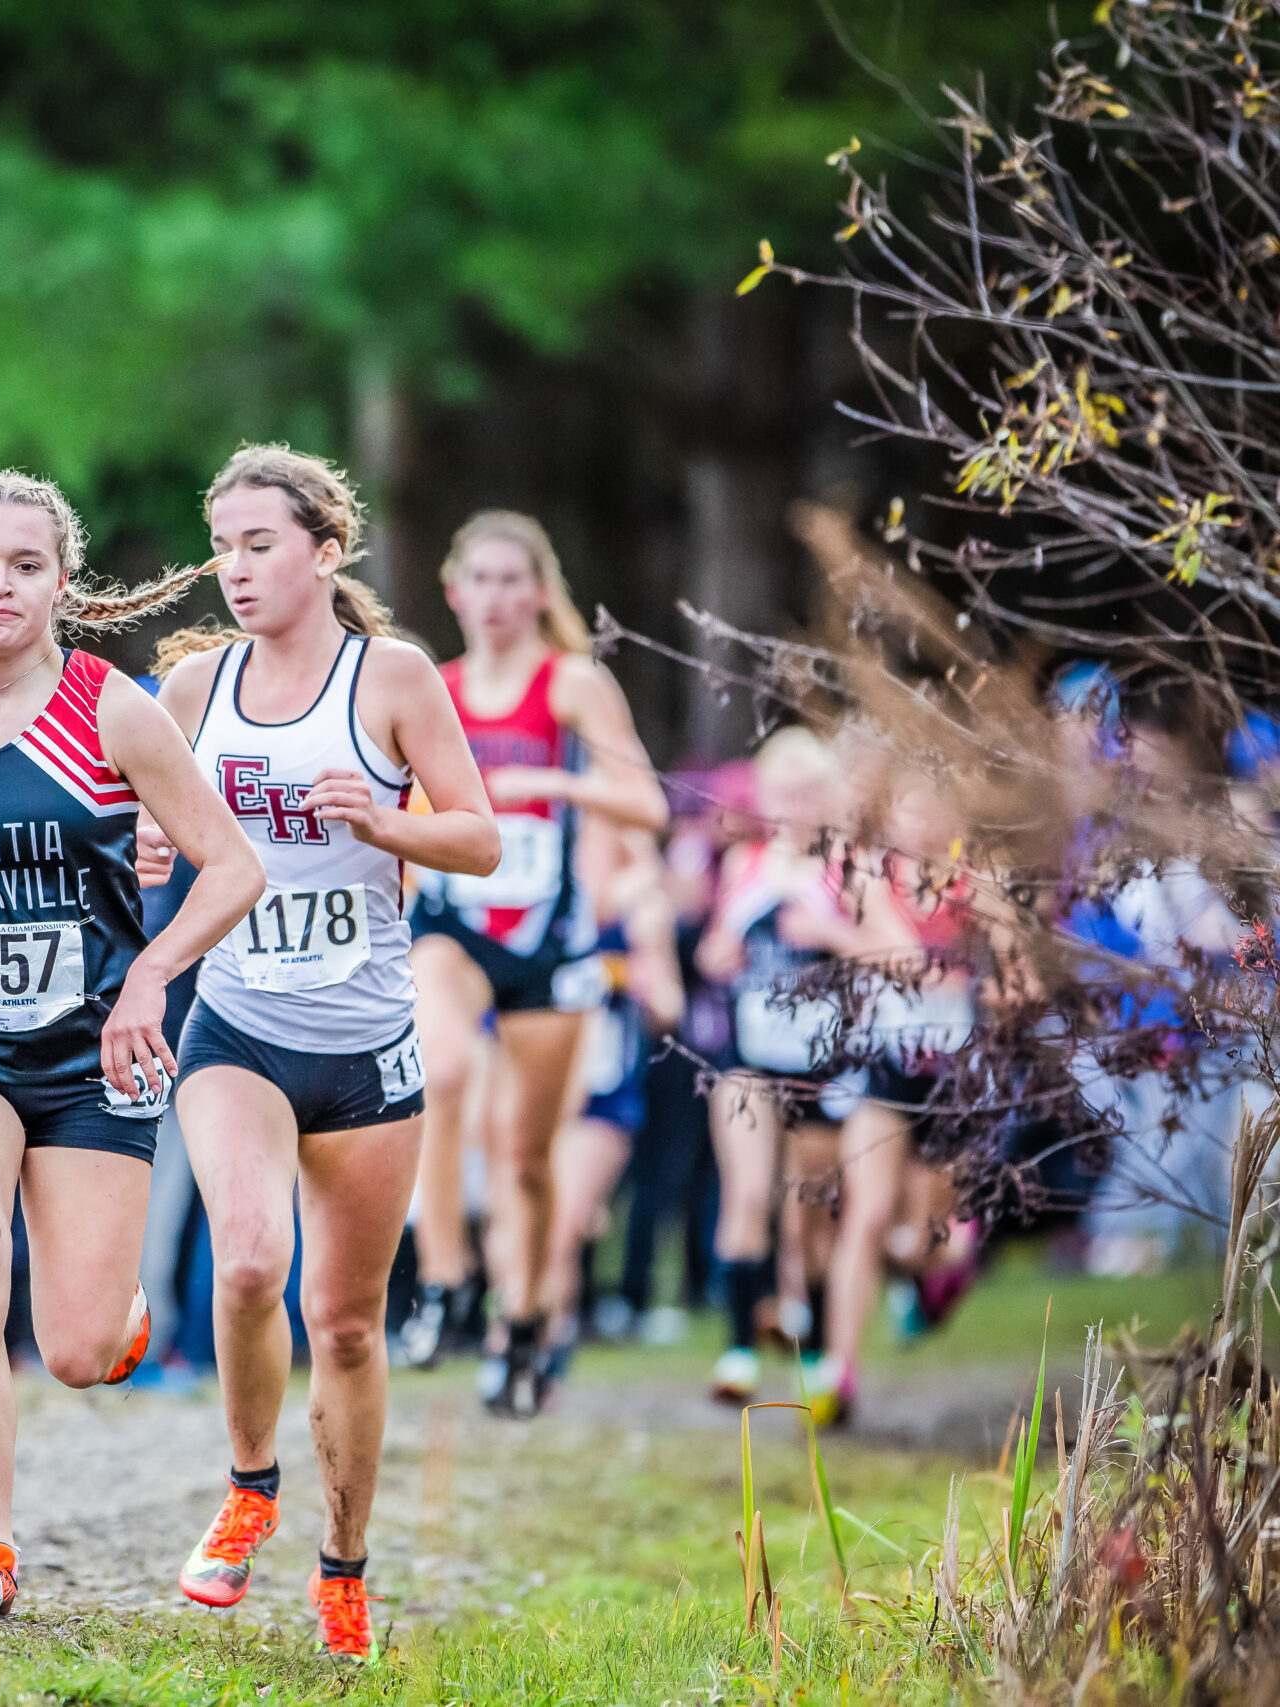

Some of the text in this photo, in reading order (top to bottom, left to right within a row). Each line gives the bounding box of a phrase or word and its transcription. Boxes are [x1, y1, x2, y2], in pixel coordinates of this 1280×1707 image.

[216, 754, 330, 846] EH
[7, 922, 71, 934] CHAMPIONSHIPS
[248, 889, 357, 955] 1178
[2, 998, 37, 1006] ATHLETIC
